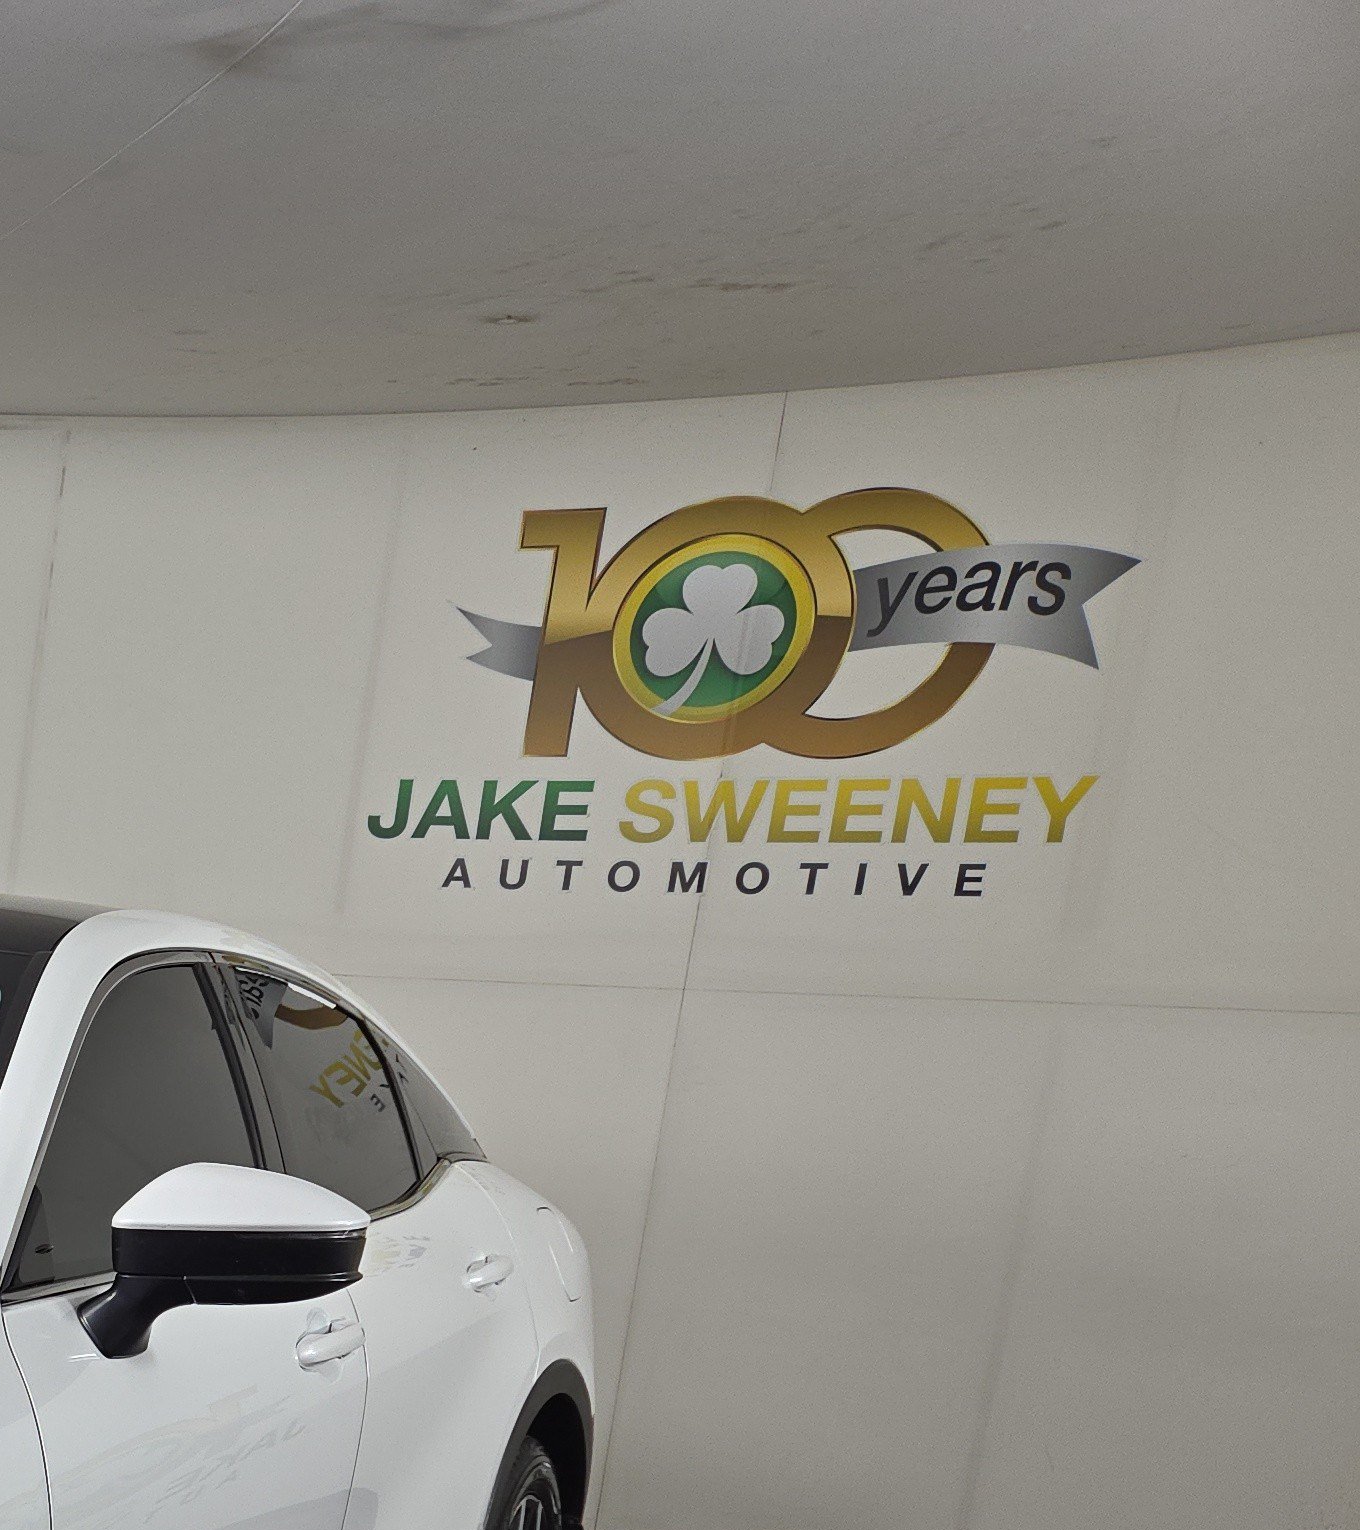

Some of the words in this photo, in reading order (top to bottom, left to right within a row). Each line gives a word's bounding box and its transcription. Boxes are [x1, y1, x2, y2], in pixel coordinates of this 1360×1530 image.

[868, 558, 1071, 638] years
[368, 779, 597, 840] JAKE
[618, 775, 1100, 844] SWEENEY
[442, 857, 988, 897] AUTOMOTIVE
